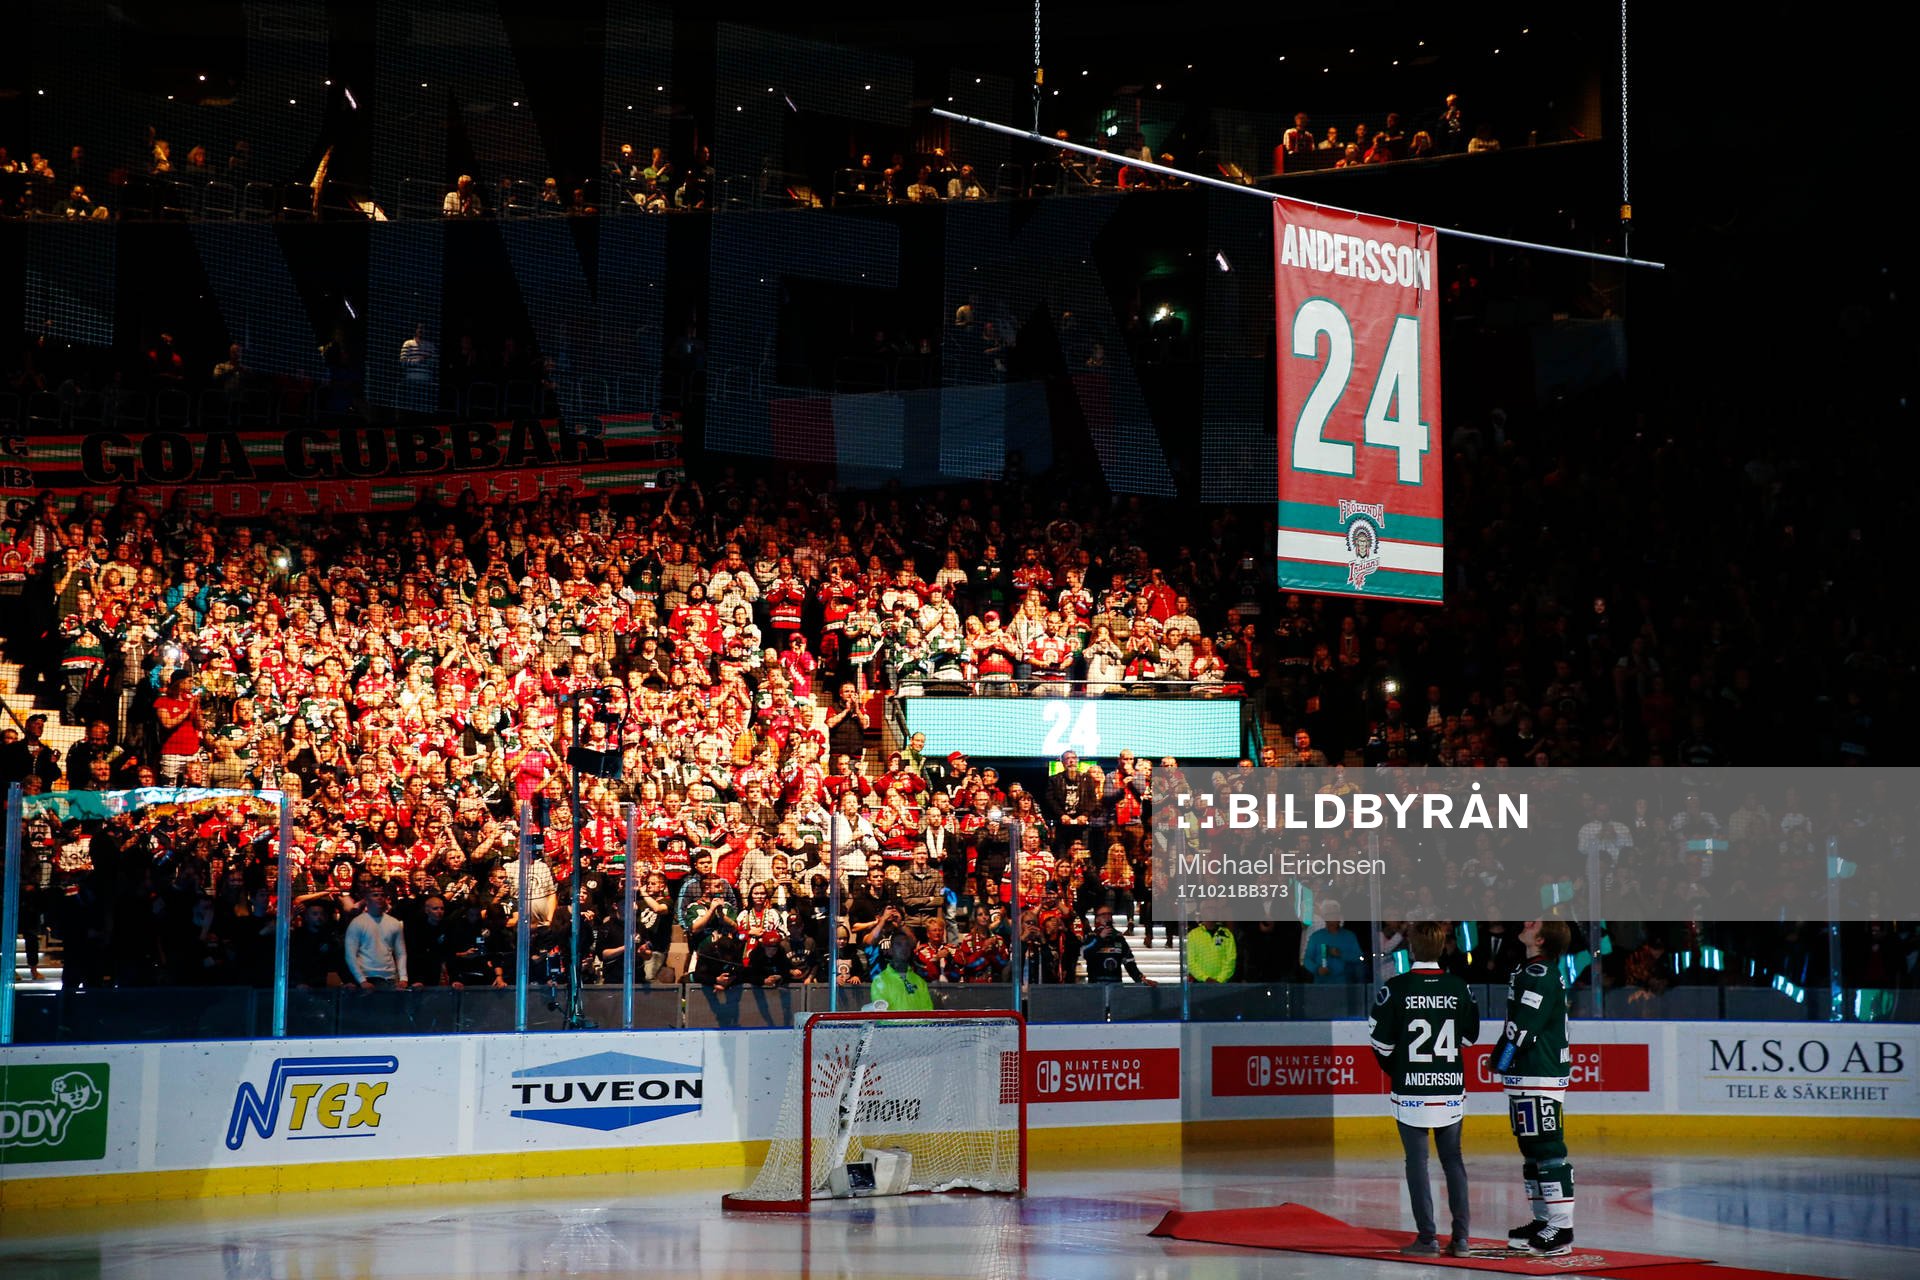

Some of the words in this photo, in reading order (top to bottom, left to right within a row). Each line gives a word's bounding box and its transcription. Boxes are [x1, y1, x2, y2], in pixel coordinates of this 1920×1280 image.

[1281, 222, 1431, 291] ANDERSSON
[1292, 296, 1430, 486] 24
[81, 431, 256, 484] GOA
[283, 416, 608, 478] GUBBAR
[1042, 700, 1100, 758] 24
[1405, 995, 1458, 1010] SERNEKE
[1408, 1018, 1459, 1063] 24
[1506, 1021, 1527, 1047] 61
[1065, 1059, 1141, 1071] NINTENDO
[1275, 1055, 1355, 1066] NINTENDO
[1709, 1039, 1830, 1073] M.S.O
[1841, 1041, 1905, 1074] AB
[1065, 1072, 1140, 1092] SWITCH
[1275, 1068, 1354, 1087] SWITCH
[1405, 1072, 1464, 1086] ANDERSSON
[514, 1080, 703, 1105] TUVEON
[1726, 1084, 1769, 1099] TELE
[1774, 1084, 1787, 1099] &
[1792, 1082, 1889, 1101] SÄKERHET
[853, 1099, 921, 1122] enova
